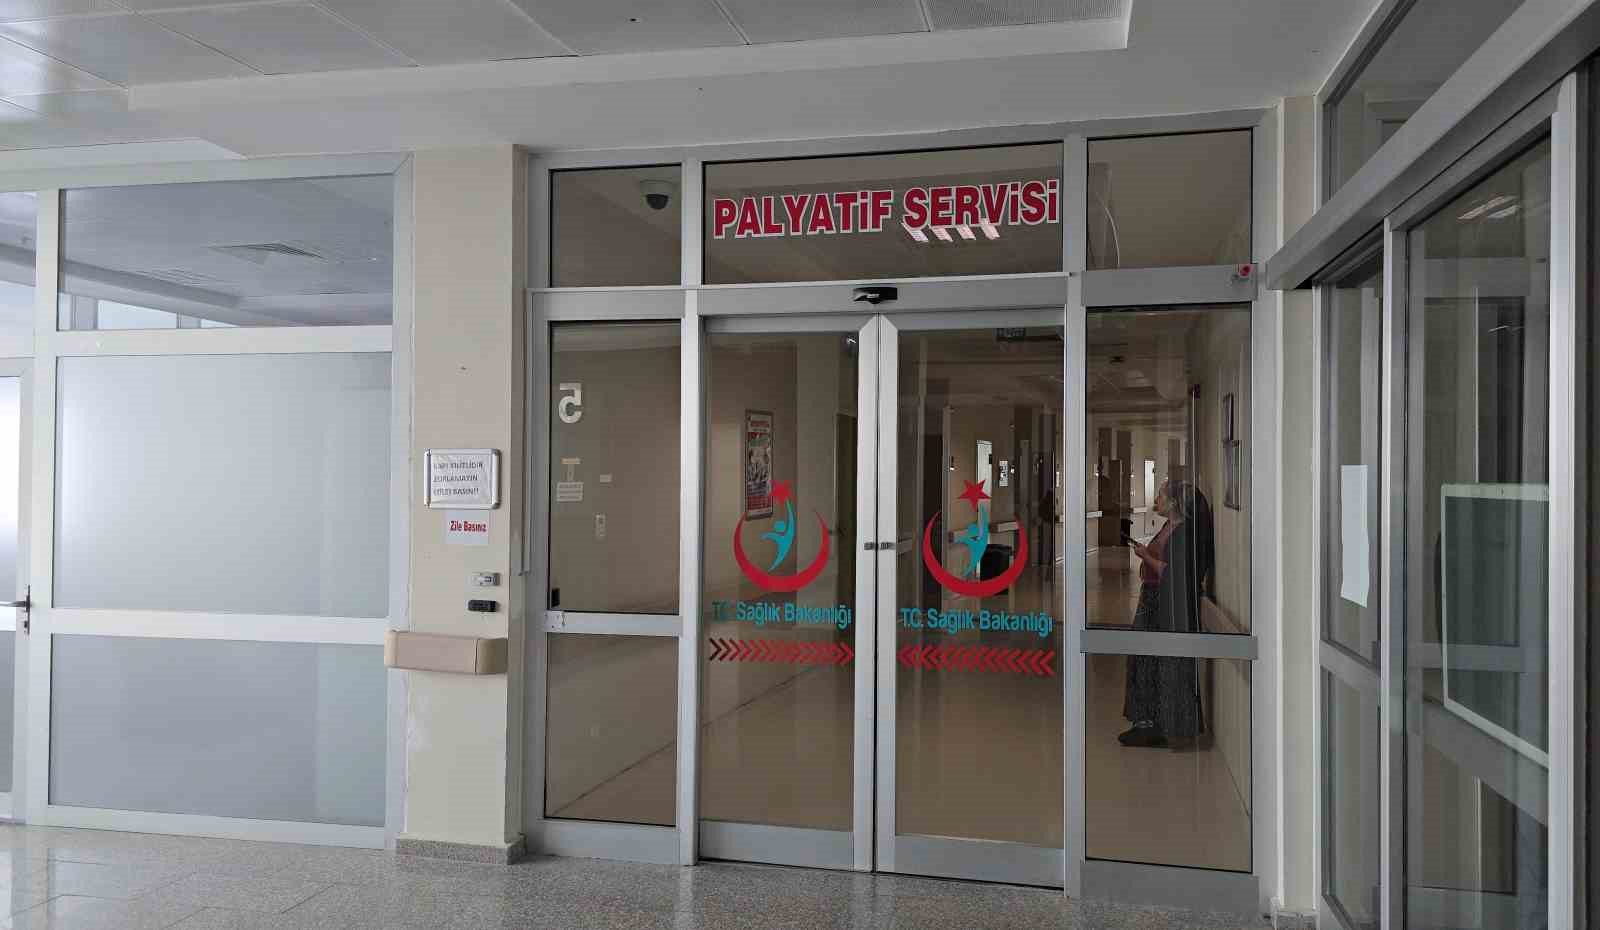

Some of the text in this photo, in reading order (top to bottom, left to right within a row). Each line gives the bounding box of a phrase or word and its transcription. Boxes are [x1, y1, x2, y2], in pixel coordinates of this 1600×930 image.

[736, 601, 780, 627] Sağlık
[784, 603, 852, 629] Bakanlığı
[927, 608, 974, 635] Sağlık
[978, 610, 1053, 638] Bakanlığı
